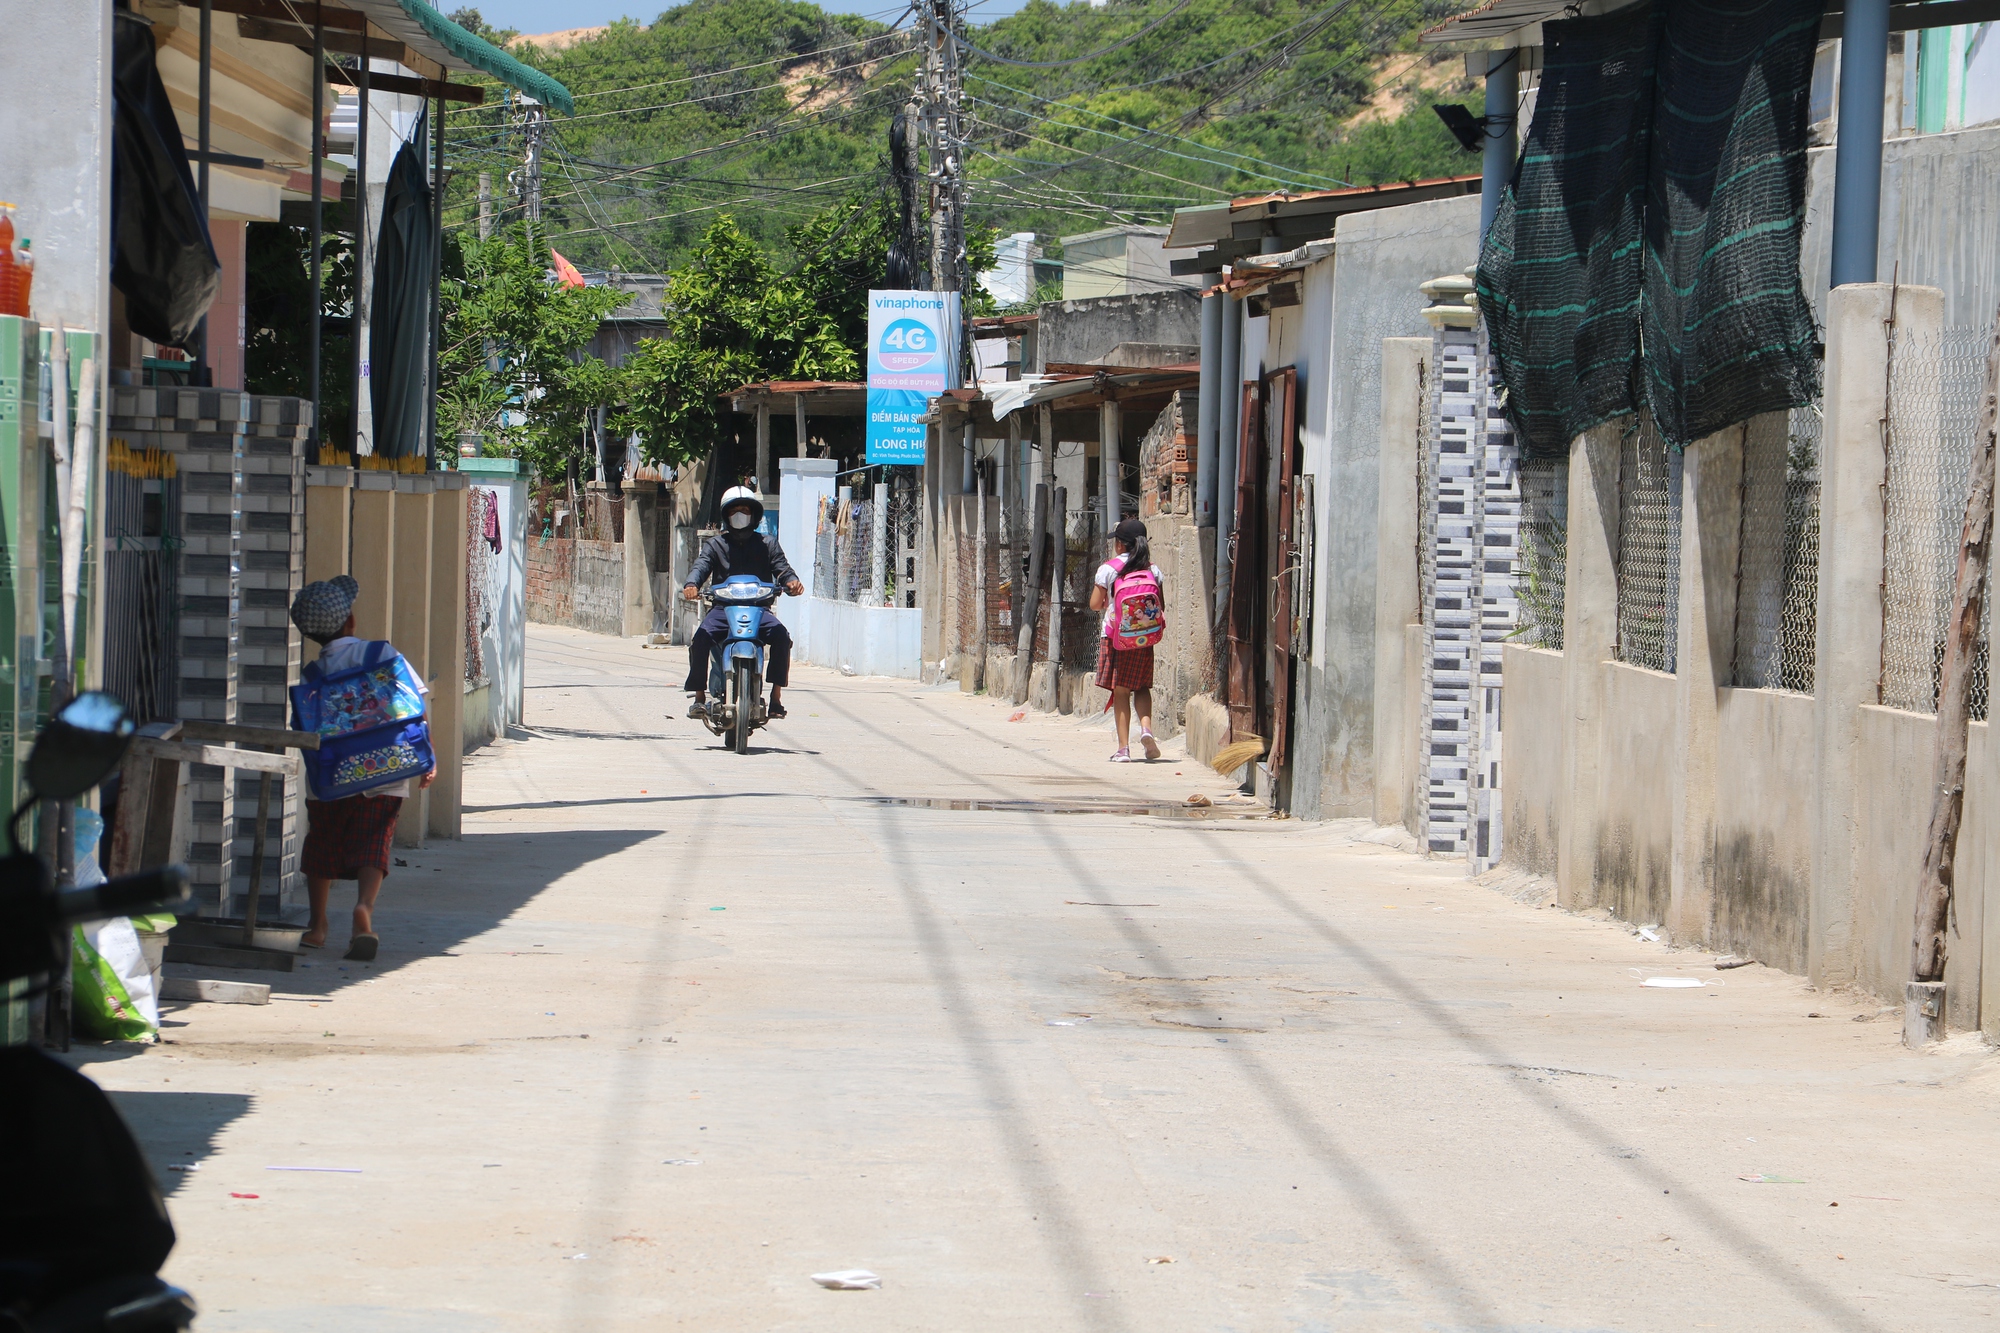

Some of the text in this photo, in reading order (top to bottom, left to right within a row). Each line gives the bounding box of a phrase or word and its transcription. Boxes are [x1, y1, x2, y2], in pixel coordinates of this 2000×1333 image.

[875, 297, 944, 310] vinaphone
[885, 327, 927, 350] 4G
[873, 377, 886, 385] TỐC
[925, 378, 939, 386] PHÁ
[872, 409, 892, 422] ĐIỂM
[893, 411, 910, 423] BÁN
[892, 426, 921, 434] TẠP HÓA
[875, 438, 908, 450] LONG
